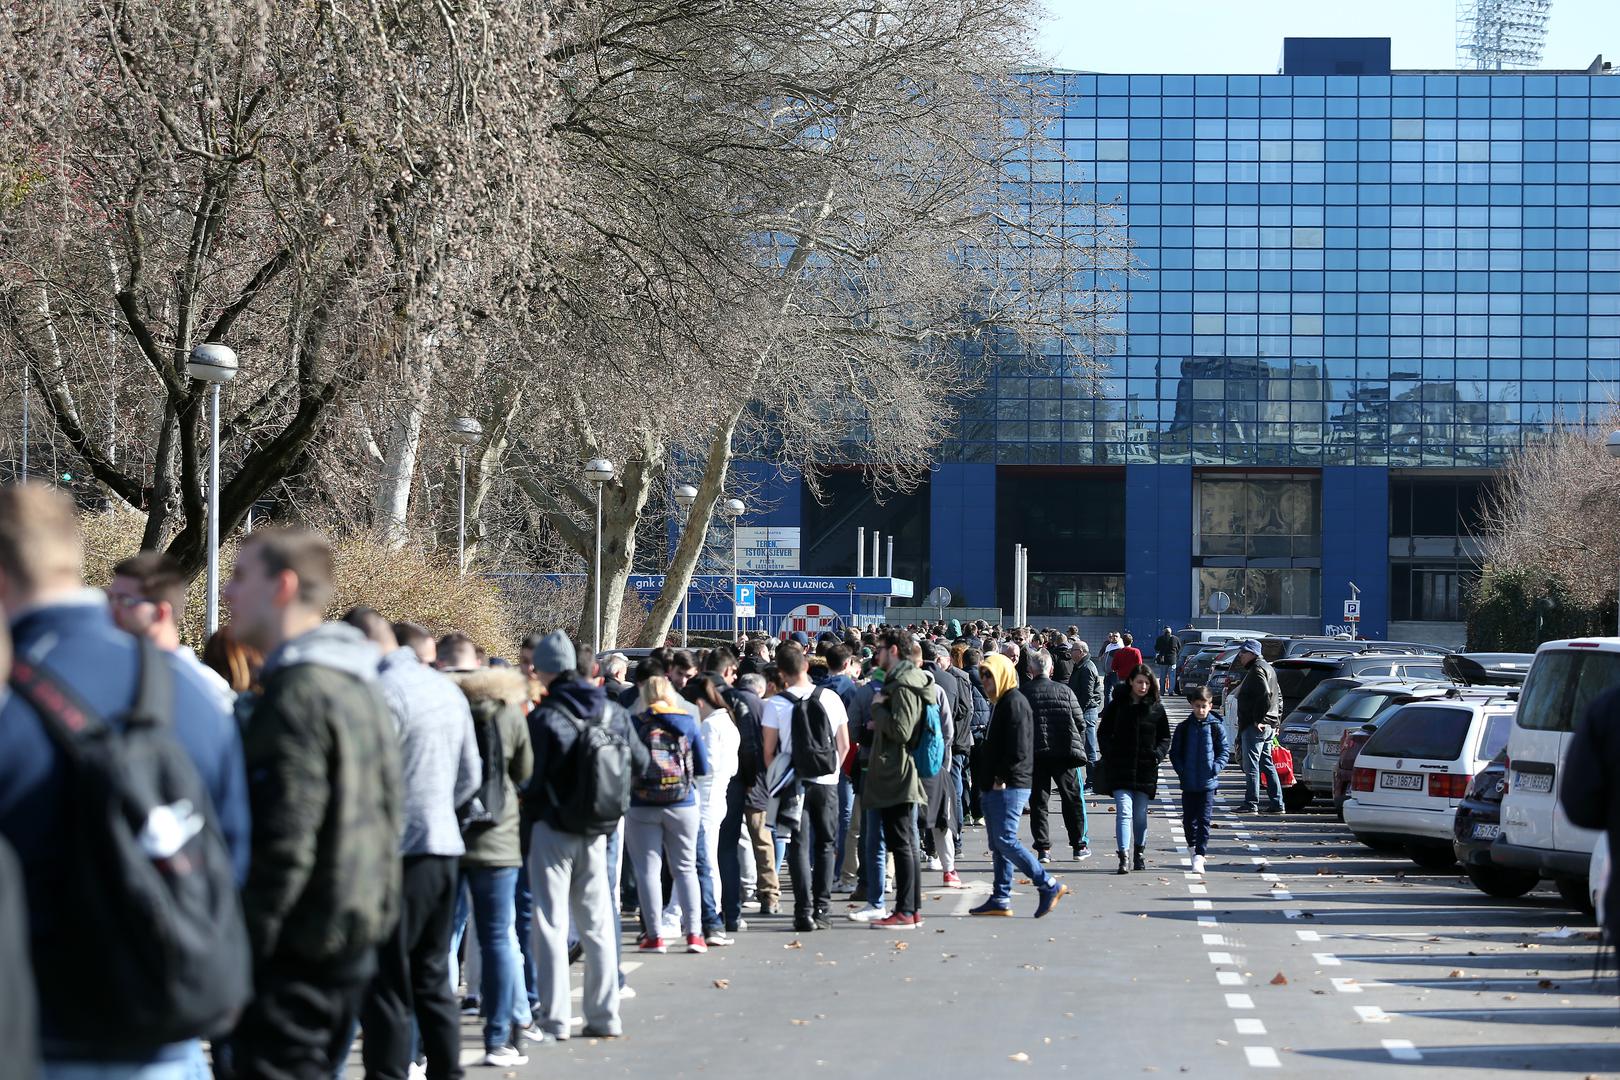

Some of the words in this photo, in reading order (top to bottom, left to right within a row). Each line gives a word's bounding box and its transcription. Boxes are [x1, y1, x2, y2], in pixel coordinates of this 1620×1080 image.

[635, 577, 655, 589] gnk
[792, 581, 835, 589] ULAZNICA
[740, 588, 750, 602] P
